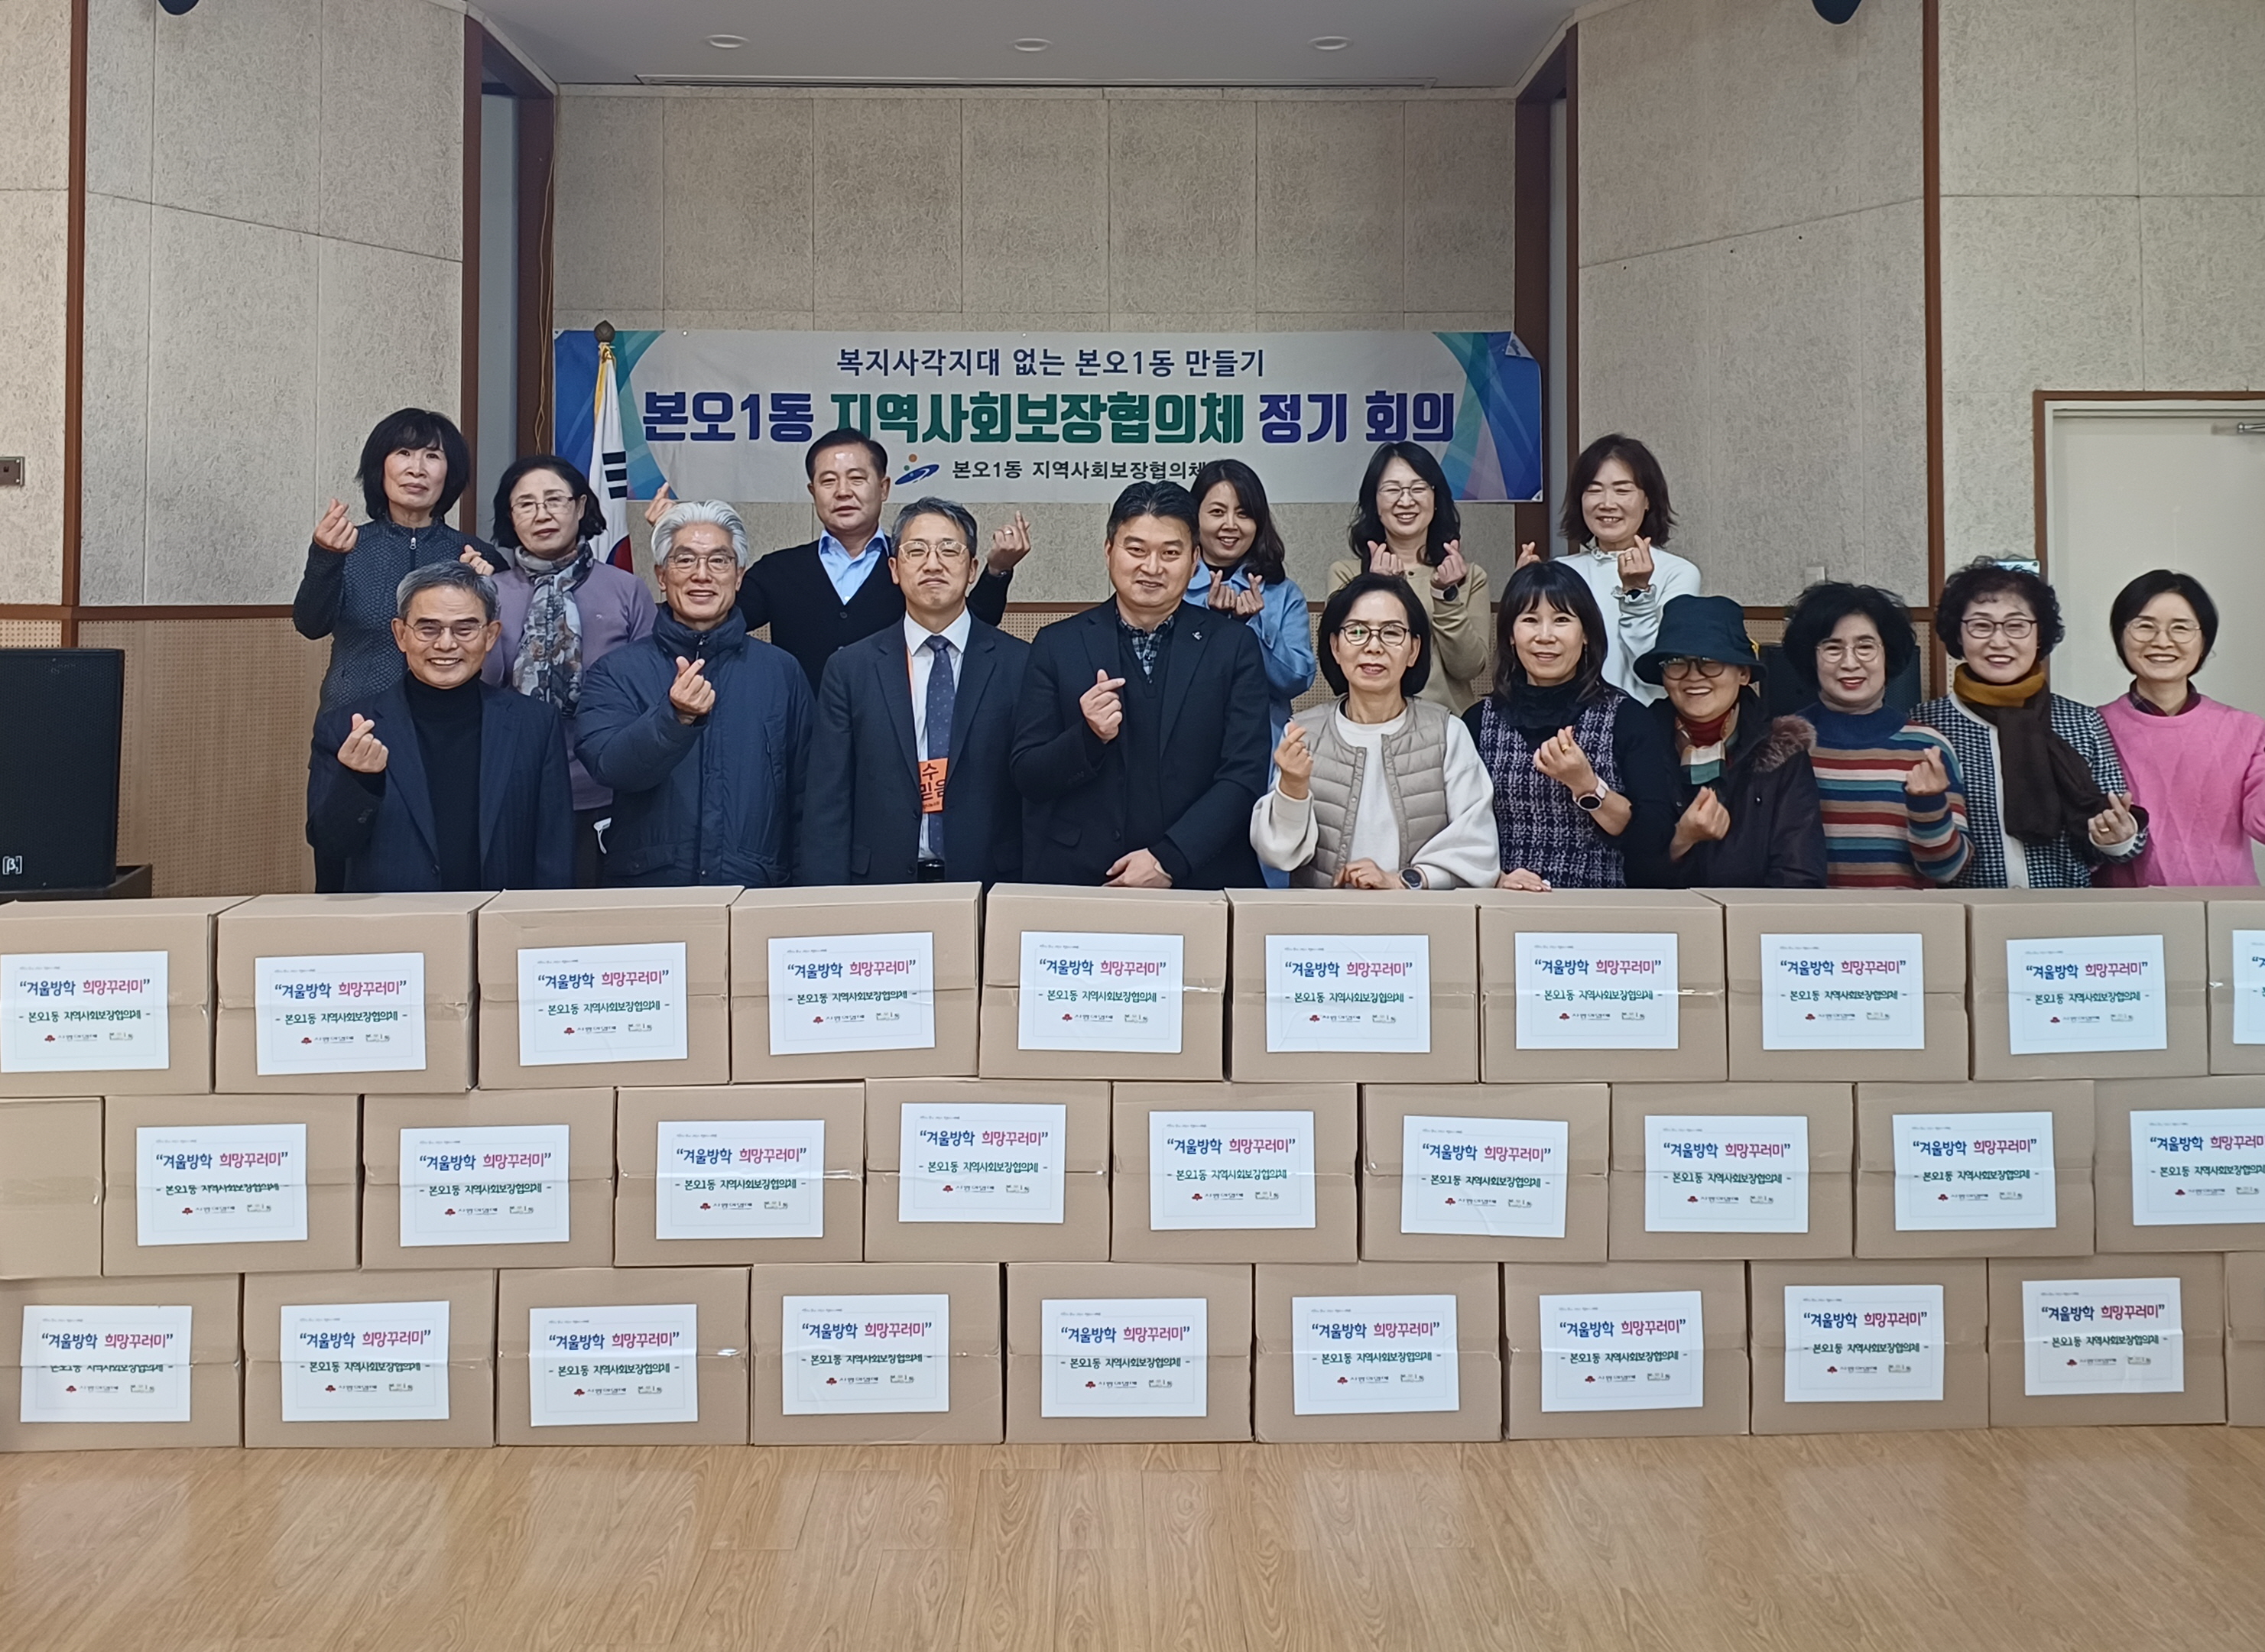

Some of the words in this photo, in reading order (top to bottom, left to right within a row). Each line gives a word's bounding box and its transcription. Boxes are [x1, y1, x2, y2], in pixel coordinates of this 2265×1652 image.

[837, 348, 1001, 377] 복지사각지대
[1012, 349, 1066, 377] 없는
[1075, 349, 1175, 377] 본오1동
[1186, 349, 1264, 377] 만들기
[642, 391, 814, 443] 본오1동
[830, 391, 1244, 443] 지역사회보장협의체
[1259, 393, 1348, 443] 정기
[1365, 390, 1454, 443] 회의
[952, 461, 1022, 479] 본오1동
[797, 992, 829, 1005] 본오1동
[1047, 989, 1079, 1002] 본오1동
[1293, 992, 1326, 1004] 본오1동
[1543, 989, 1575, 1001] 본오1동
[1790, 990, 1820, 1002] 본오1동
[2034, 992, 2065, 1006] 본오1동
[547, 1003, 579, 1017] 본오1동
[28, 1011, 60, 1024] 본오1동
[284, 1013, 317, 1026] 본오1동
[927, 1160, 959, 1173] 본오1동
[2160, 1166, 2190, 1178] 본오1동
[1176, 1169, 1208, 1182] 본오1동
[1430, 1174, 1462, 1186] 본오1동
[1672, 1171, 1704, 1184] 본오1동
[1922, 1170, 1954, 1183] 본오1동
[428, 1184, 461, 1197] 본오1동
[684, 1179, 716, 1191] 본오1동
[1812, 1342, 1844, 1355] 본오1동
[2052, 1336, 2082, 1349] 본오1동
[810, 1355, 842, 1367] 본오1동
[1069, 1358, 1102, 1370] 본오1동
[1321, 1352, 1353, 1365] 본오1동
[1569, 1352, 1601, 1365] 본오1동
[309, 1361, 341, 1374] 본오1동
[557, 1365, 589, 1378] 본오1동
